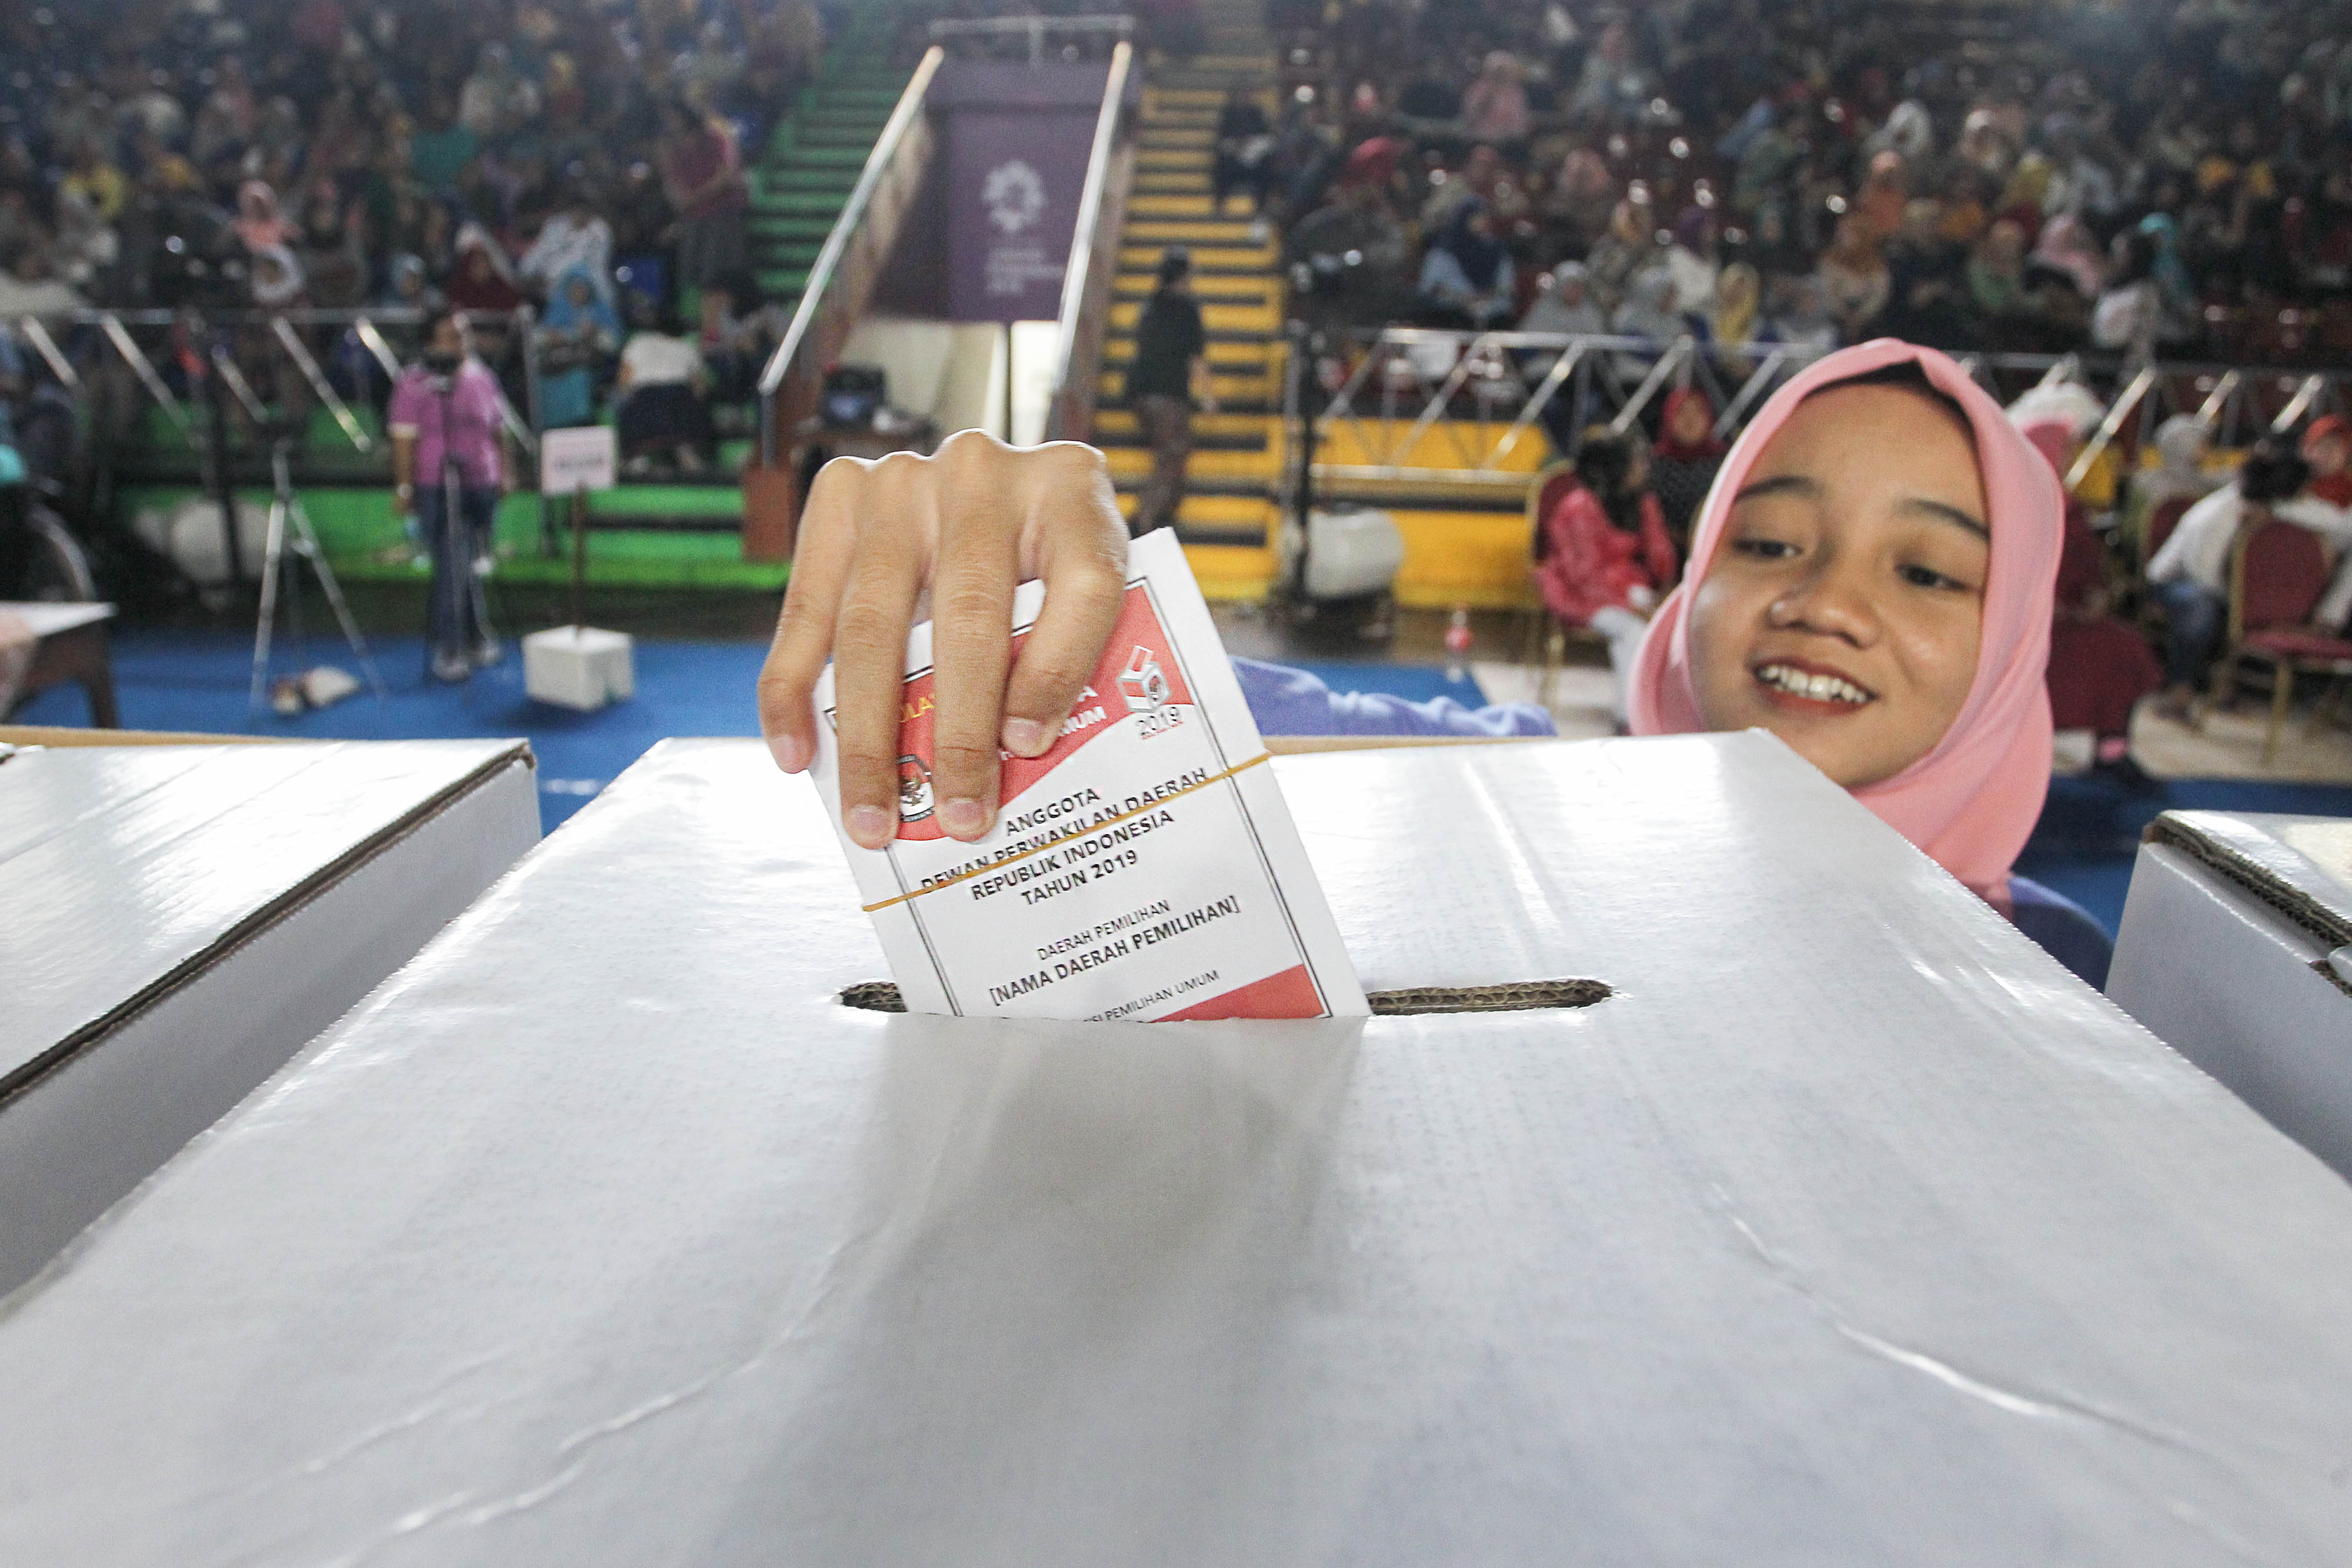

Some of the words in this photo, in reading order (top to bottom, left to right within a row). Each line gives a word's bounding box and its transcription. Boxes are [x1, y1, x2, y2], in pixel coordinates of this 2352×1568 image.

[1058, 706, 1108, 736] MUM
[1135, 706, 1180, 738] 2019
[993, 804, 1120, 861] PERWAKILAN
[1125, 768, 1209, 811] DAERAH
[1007, 788, 1100, 836] ANGGOTA
[971, 855, 1061, 900] REPUBLIK
[1063, 810, 1175, 864] INDONESIA
[1021, 870, 1088, 905] TAHUN
[1091, 850, 1138, 878] 2019
[988, 971, 1054, 1006] [NAMA
[1054, 940, 1130, 979] DAERAH
[1132, 895, 1241, 949] PEMILIHAN]
[1037, 930, 1093, 961] DAERAH
[1095, 900, 1171, 938] PEMILIHAN
[1105, 987, 1174, 1021] PEMILIHAN
[1174, 970, 1220, 994] UMUM
